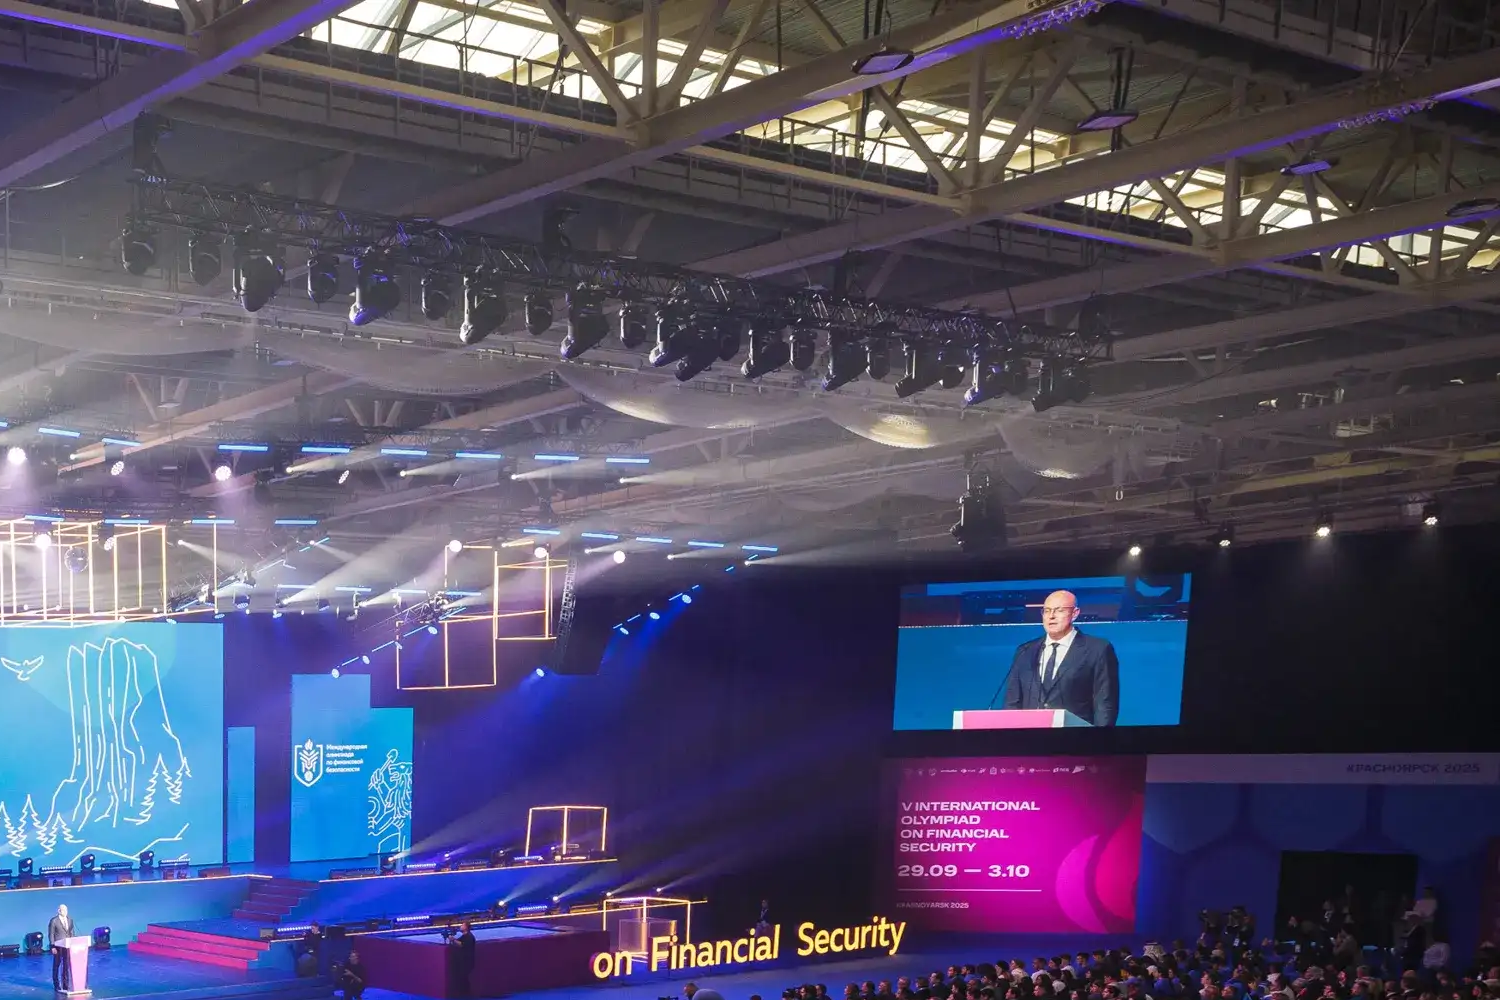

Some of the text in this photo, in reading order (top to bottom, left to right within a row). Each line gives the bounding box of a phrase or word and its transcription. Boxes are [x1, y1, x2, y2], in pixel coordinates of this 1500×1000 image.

[1346, 763, 1480, 773] КРАСНОЯРСК 2025
[901, 801, 1040, 811] V INTERNATIONAL
[901, 815, 981, 825] OLYMPIAD
[900, 828, 1010, 839] ON FINANCIAL
[900, 842, 977, 852] SECURITY
[897, 864, 958, 877] 29.09
[988, 864, 1030, 878] 3.10
[592, 915, 907, 979] on Financial Security
